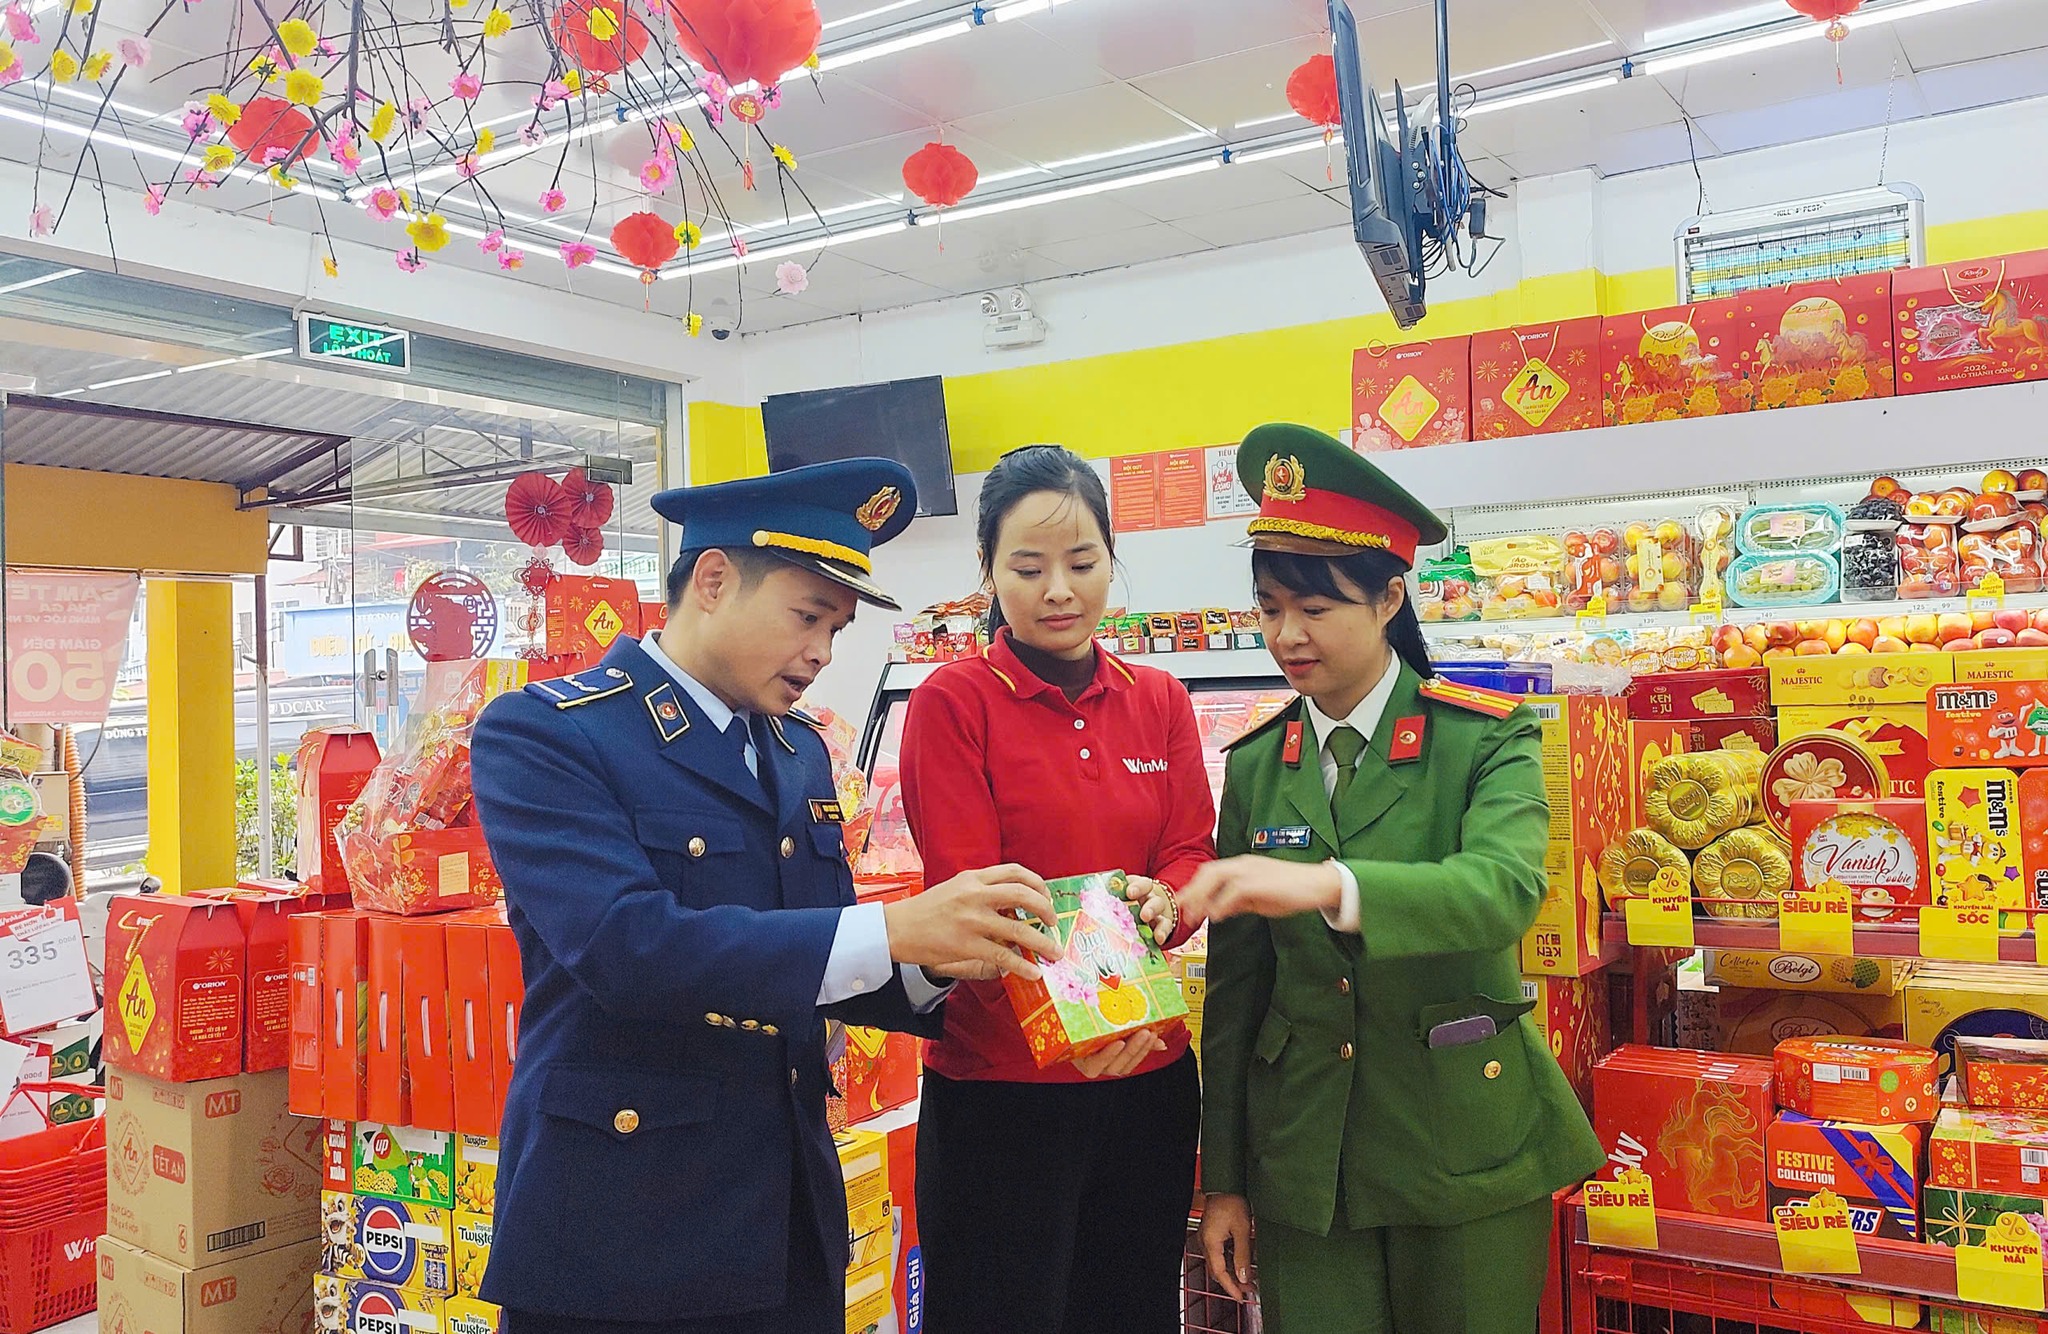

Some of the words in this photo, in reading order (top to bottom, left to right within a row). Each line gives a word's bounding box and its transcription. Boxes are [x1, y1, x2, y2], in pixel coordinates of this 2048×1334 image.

[329, 324, 384, 346] EXIT
[1963, 364, 1987, 372] 2026
[1517, 373, 1556, 404] An
[1392, 391, 1423, 419] An
[593, 611, 616, 631] An
[1781, 676, 1823, 686] MAJESTIC
[1967, 670, 2014, 679] MAJESTIC
[280, 699, 327, 715] DCAR
[1650, 693, 1672, 704] KEN
[1660, 704, 1672, 714] JU
[1810, 839, 1900, 874] Vanish
[1783, 896, 1822, 913] SIÊU
[1956, 910, 1989, 924] SỐC
[7, 940, 58, 969] 335
[201, 980, 226, 989] ORION
[126, 978, 148, 1020] An
[111, 1078, 123, 1099] MT
[207, 1091, 240, 1116] MT
[463, 1133, 488, 1147] Twister
[124, 1136, 139, 1164] An
[170, 1161, 184, 1178] AN
[1776, 1150, 1834, 1171] FESTIVE
[1777, 1167, 1836, 1185] COLLECTION
[1588, 1190, 1625, 1207] SIÊU
[1780, 1214, 1820, 1231] SIÊU
[366, 1230, 403, 1250] PEPSI
[1990, 1243, 2038, 1255] KHUYẾN
[102, 1258, 114, 1278] MT
[2003, 1254, 2026, 1264] MÃI
[203, 1279, 236, 1305] MT
[360, 1316, 397, 1334] PEPSI
